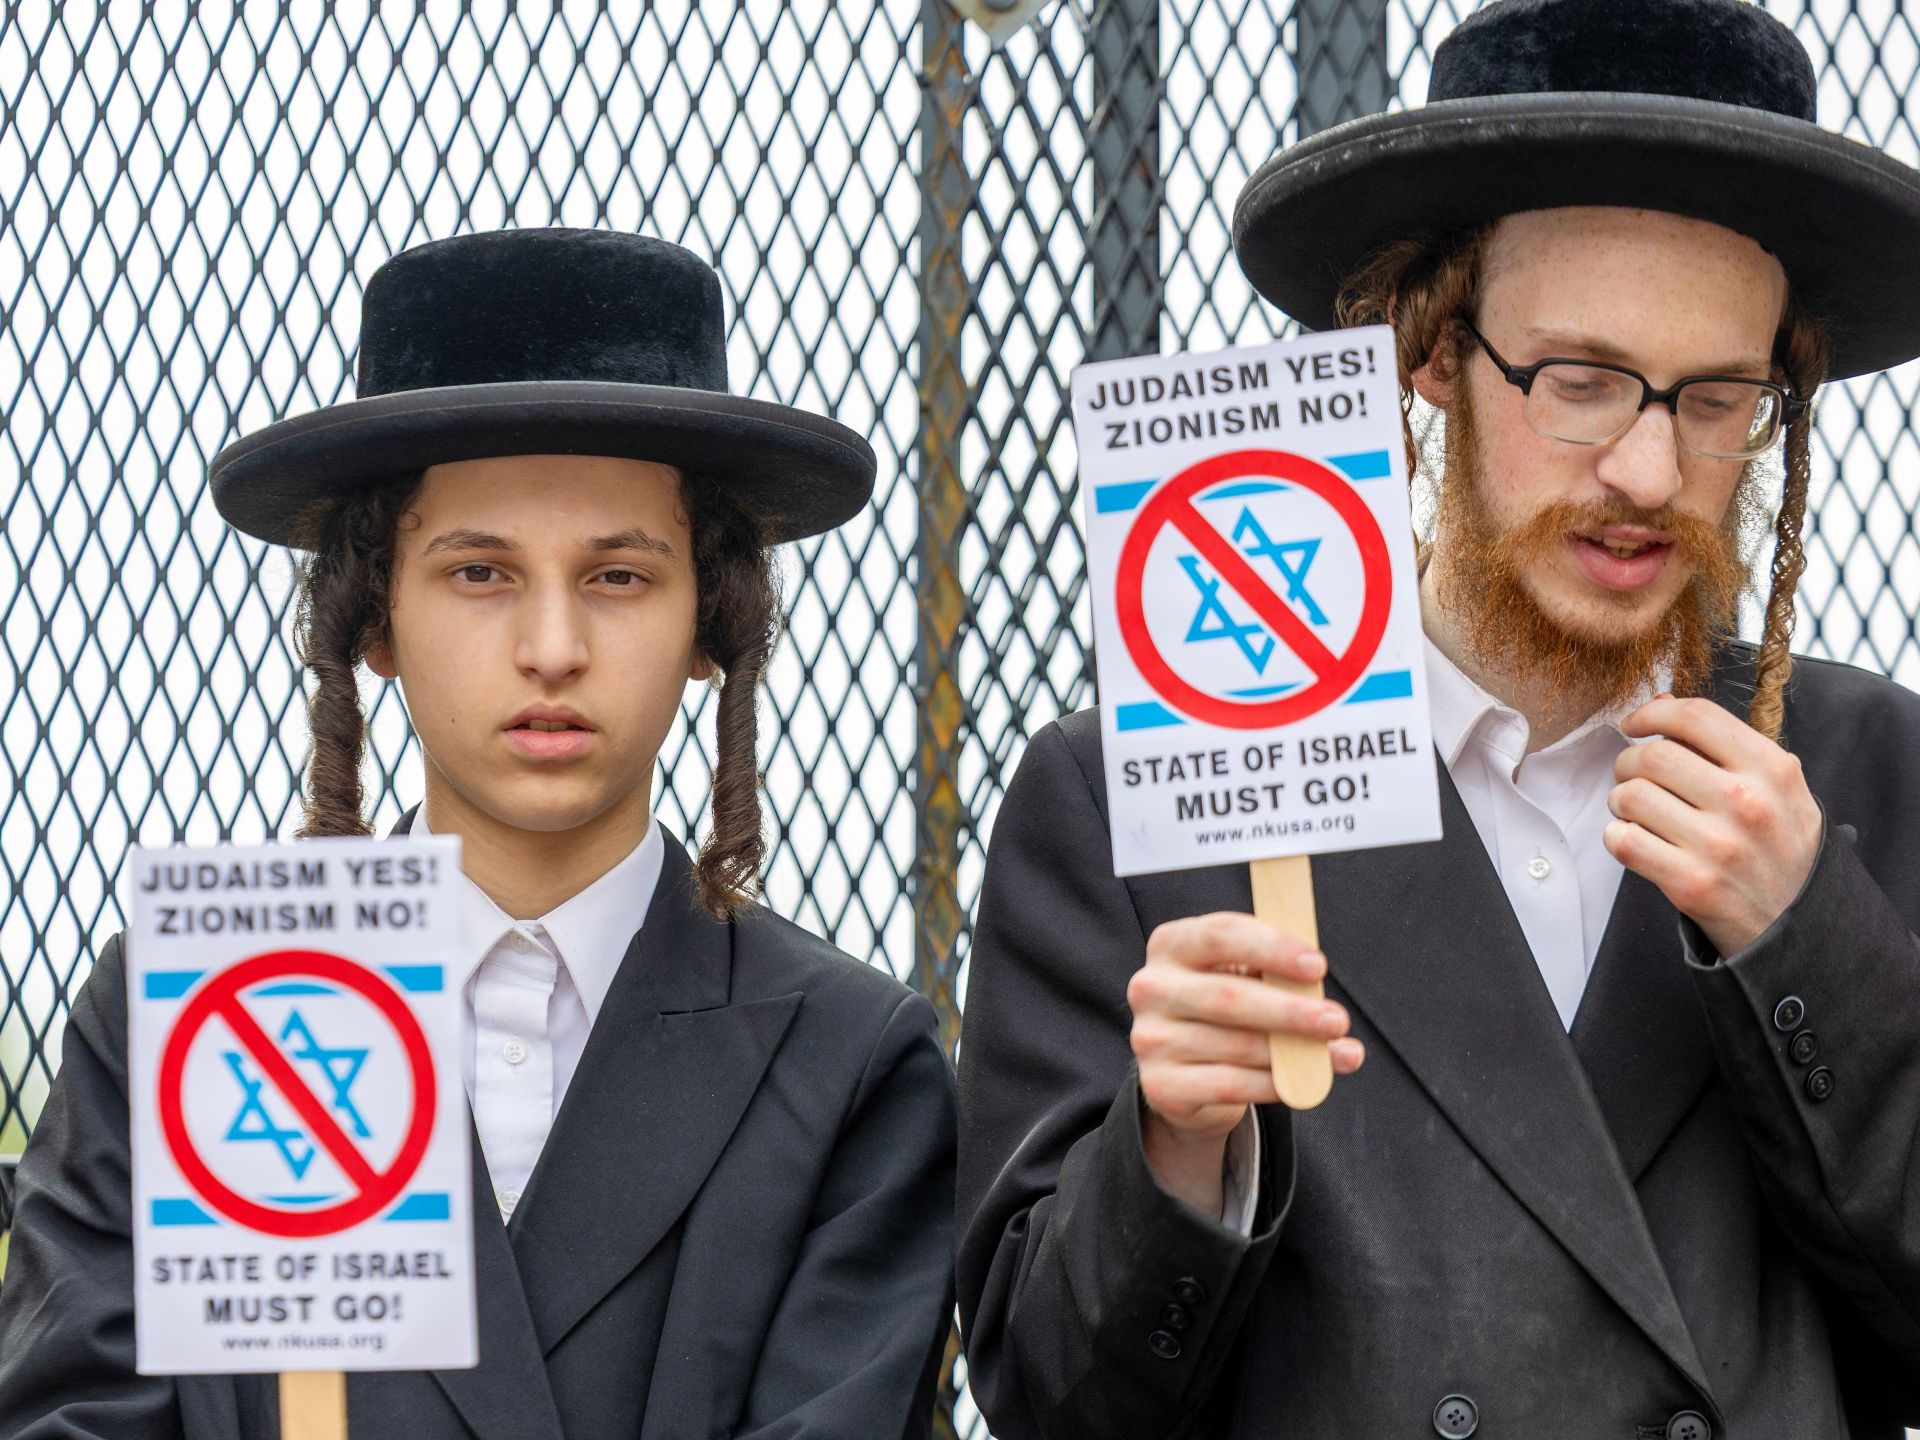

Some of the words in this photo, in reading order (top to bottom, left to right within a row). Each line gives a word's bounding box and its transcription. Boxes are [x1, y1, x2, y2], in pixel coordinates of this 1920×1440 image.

[1088, 362, 1269, 410] JUDAISM
[1284, 347, 1376, 383] YES!
[1105, 403, 1280, 449] ZIONISM
[1299, 391, 1367, 424] NO!
[1122, 750, 1229, 787] STATE
[1243, 744, 1283, 771] OF
[1299, 729, 1417, 765] ISRAEL
[1176, 784, 1285, 820] MUST
[1303, 774, 1370, 805] GO!
[1197, 816, 1356, 845] www.nkusa.org
[141, 860, 326, 894] JUDAISM
[346, 857, 437, 887] YES!
[157, 903, 336, 936] ZIONISM
[356, 901, 426, 929] NO!
[154, 1255, 260, 1284] STATE
[277, 1254, 317, 1281] OF
[334, 1252, 451, 1280] ISRAEL
[205, 1295, 315, 1323] MUST
[334, 1294, 401, 1322] GO!
[224, 1333, 383, 1352] www.nkusa.org
